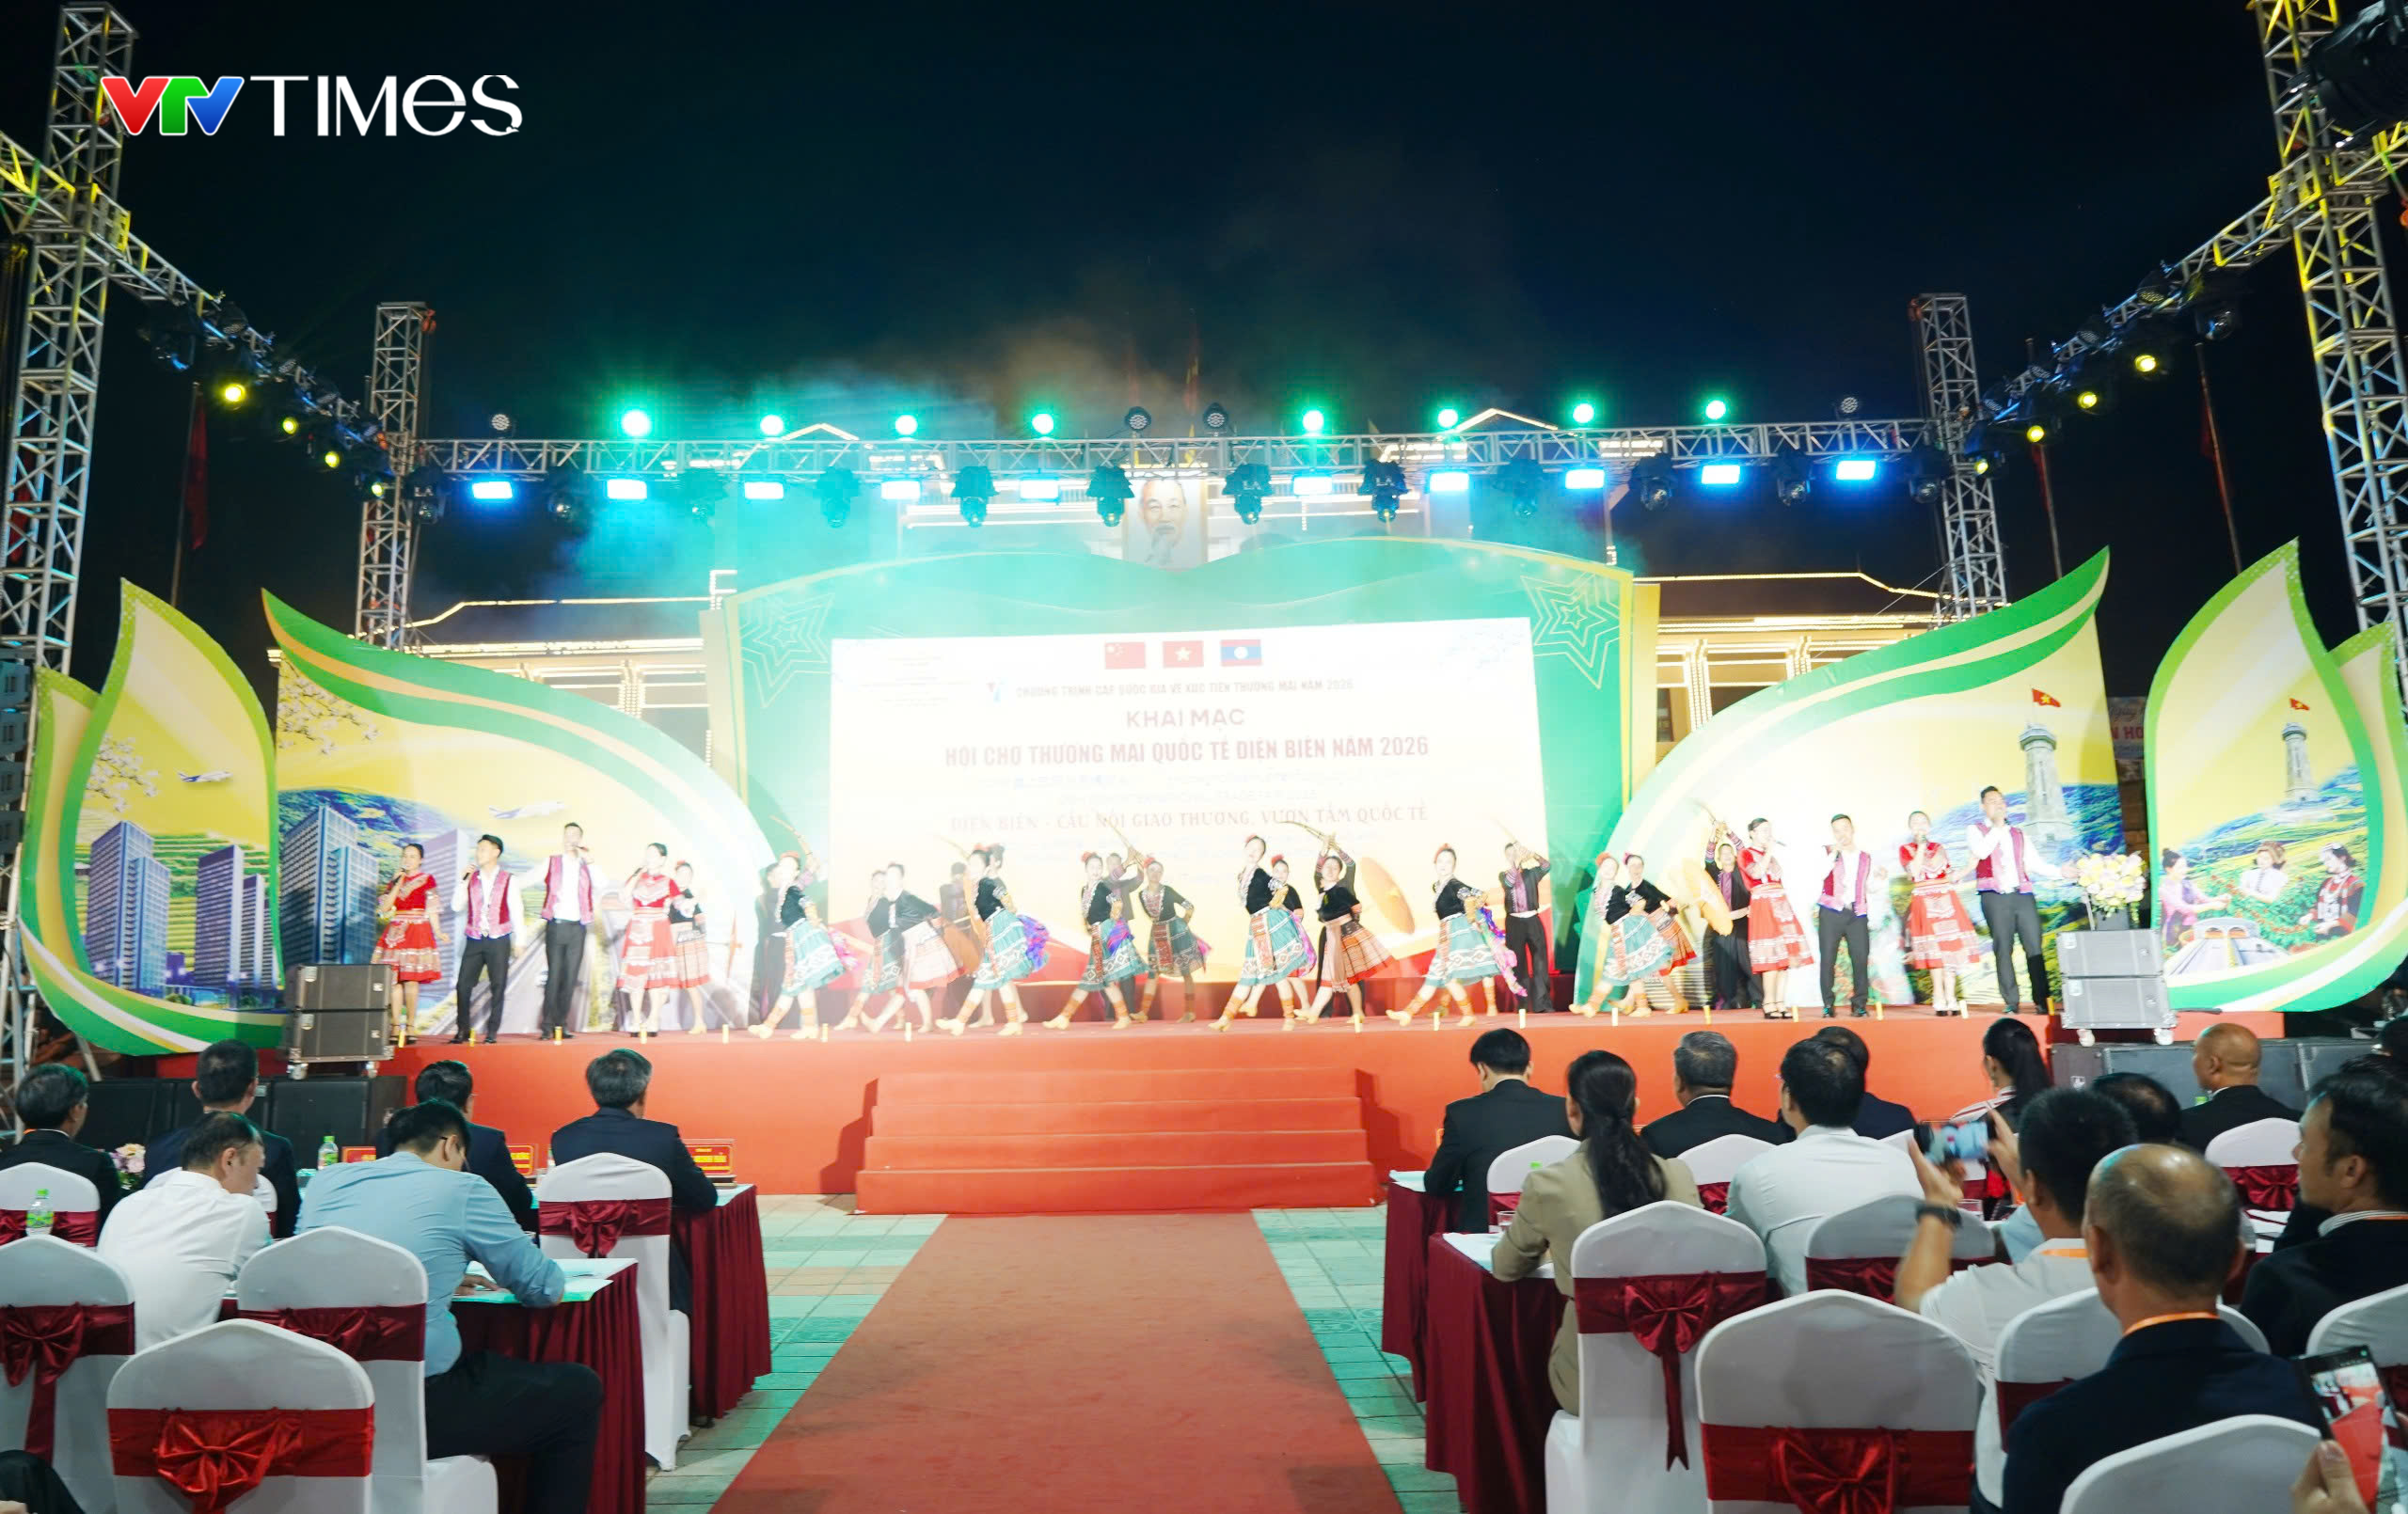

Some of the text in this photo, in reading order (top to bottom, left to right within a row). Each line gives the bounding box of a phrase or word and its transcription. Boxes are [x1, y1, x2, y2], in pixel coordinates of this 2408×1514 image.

[1126, 709, 1183, 728] KHAI
[1380, 735, 1428, 757] 2026
[1132, 812, 1173, 828] GIAO
